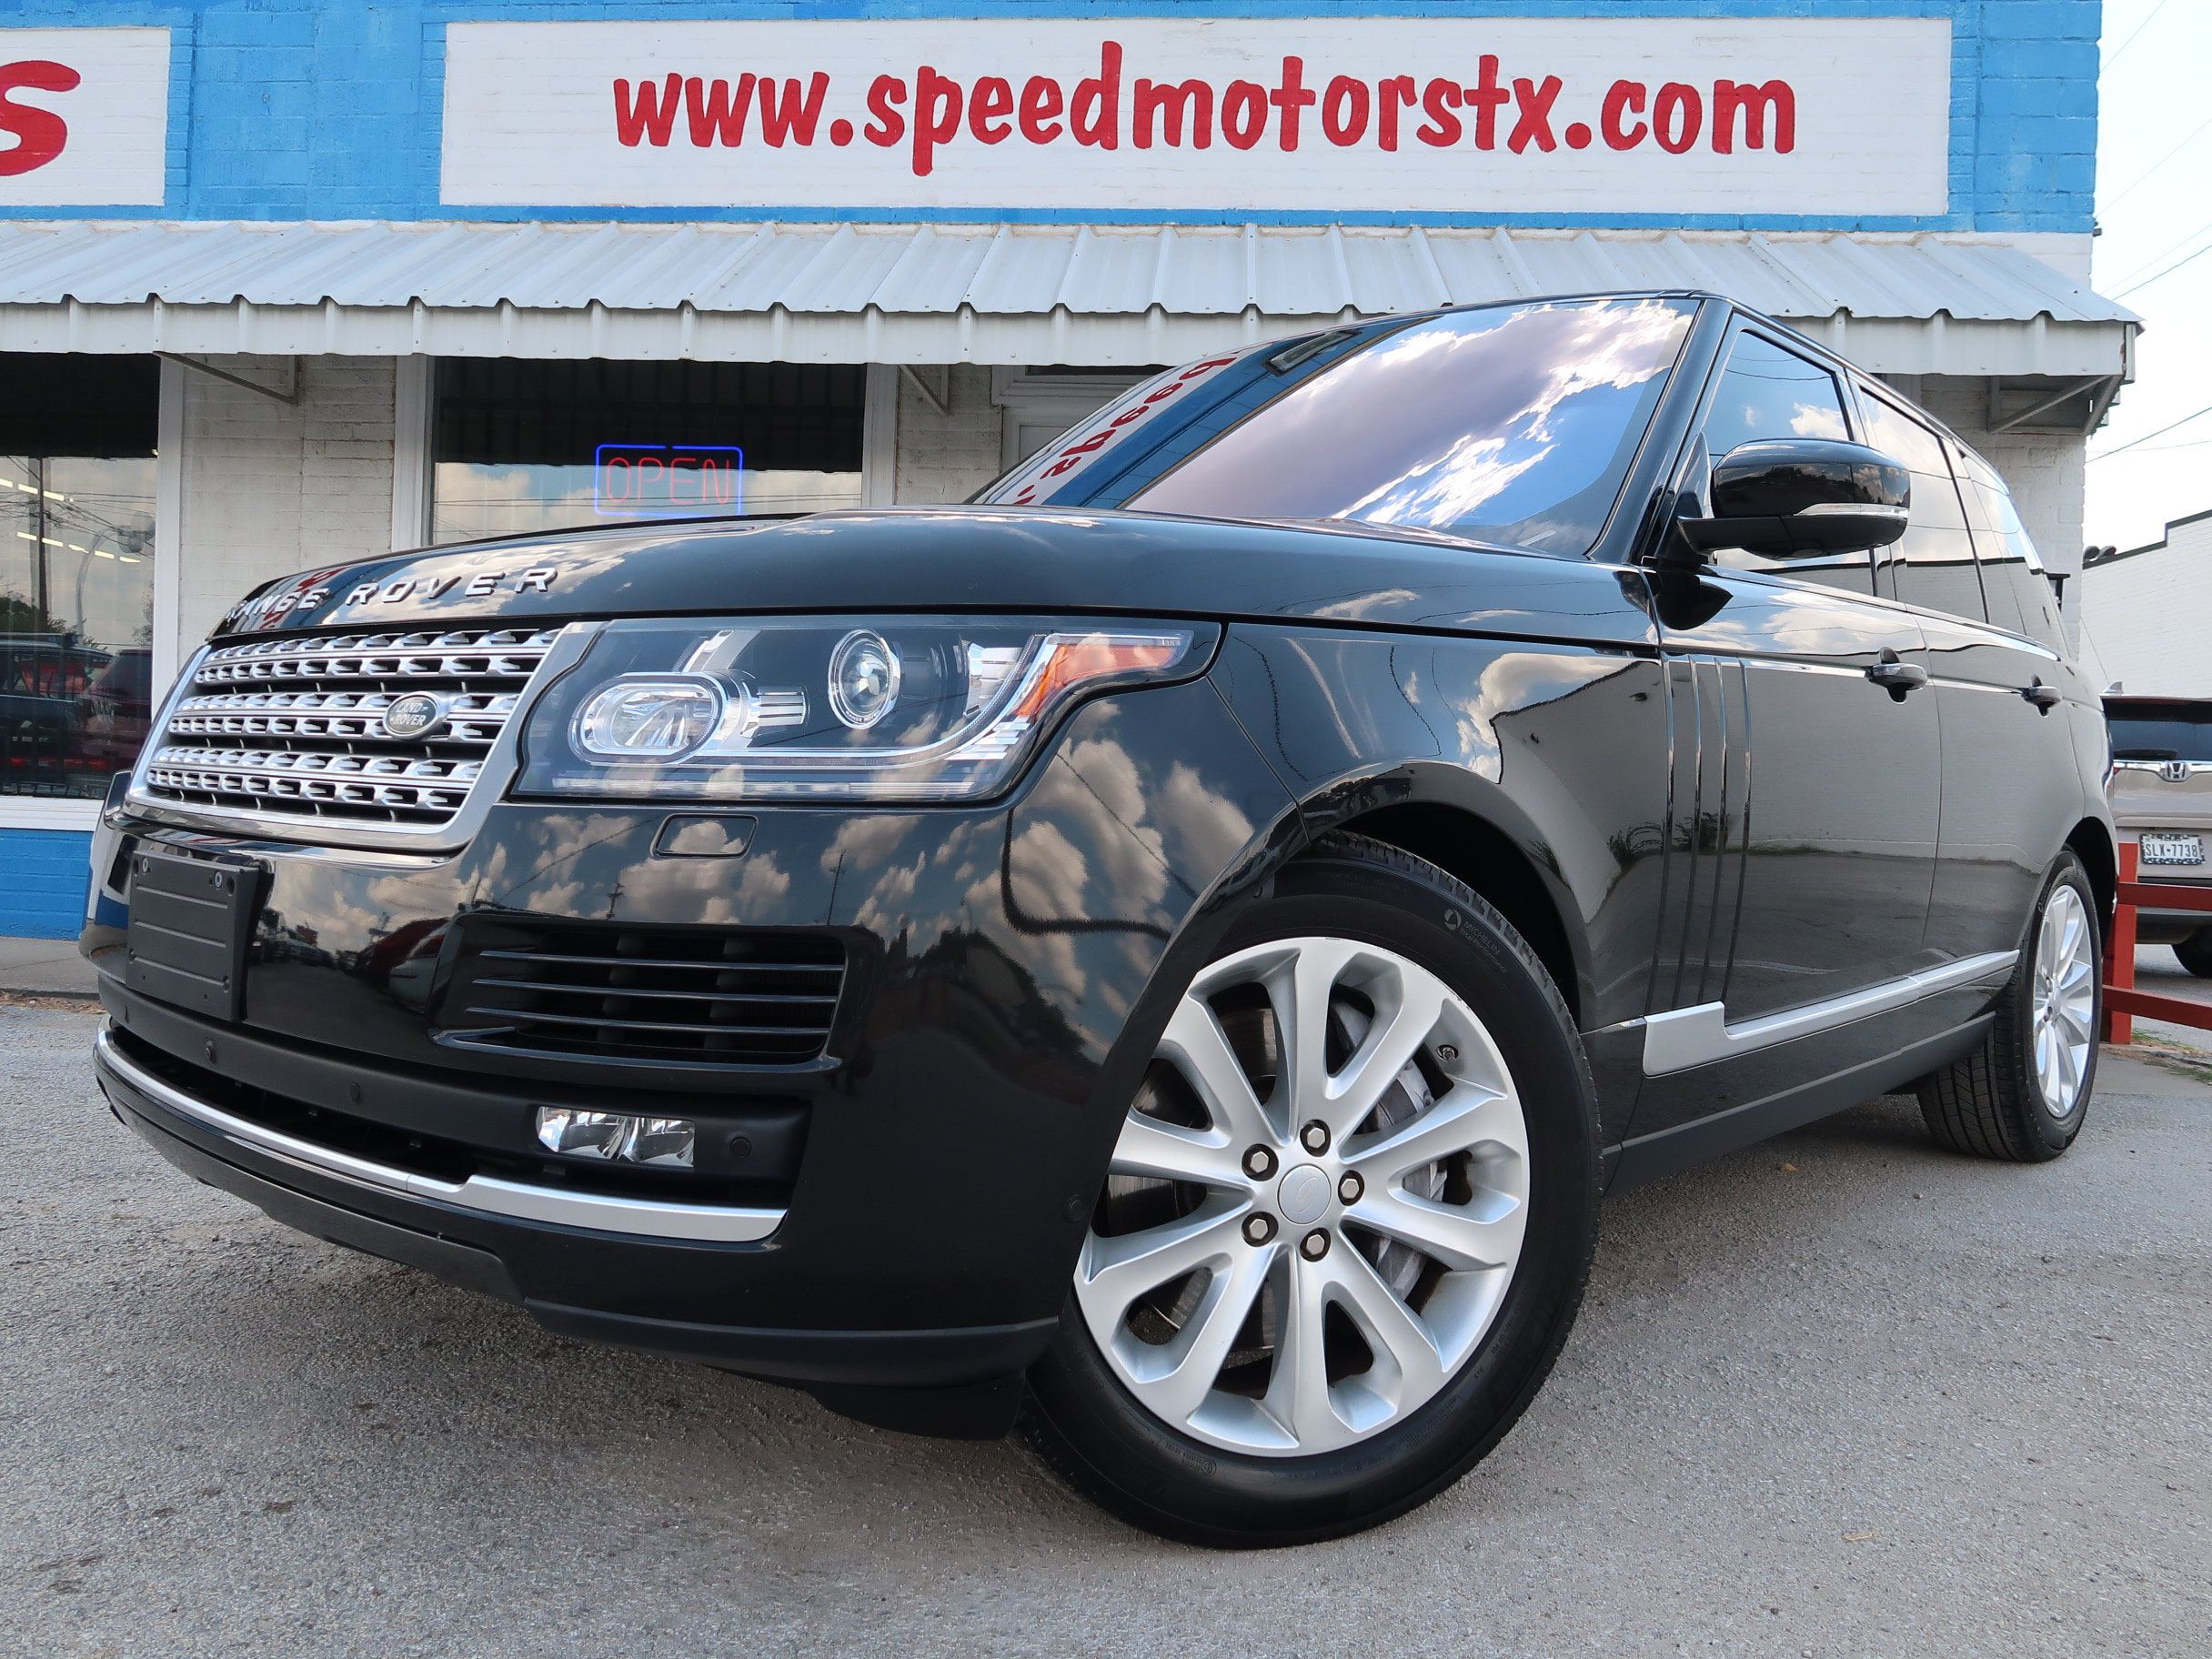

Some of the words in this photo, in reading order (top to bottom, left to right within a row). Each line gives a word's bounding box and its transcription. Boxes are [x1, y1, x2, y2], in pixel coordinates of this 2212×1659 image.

[614, 40, 1795, 176] www.speedmotorstx.com
[607, 457, 731, 505] OPEN
[345, 567, 558, 605] ROVER
